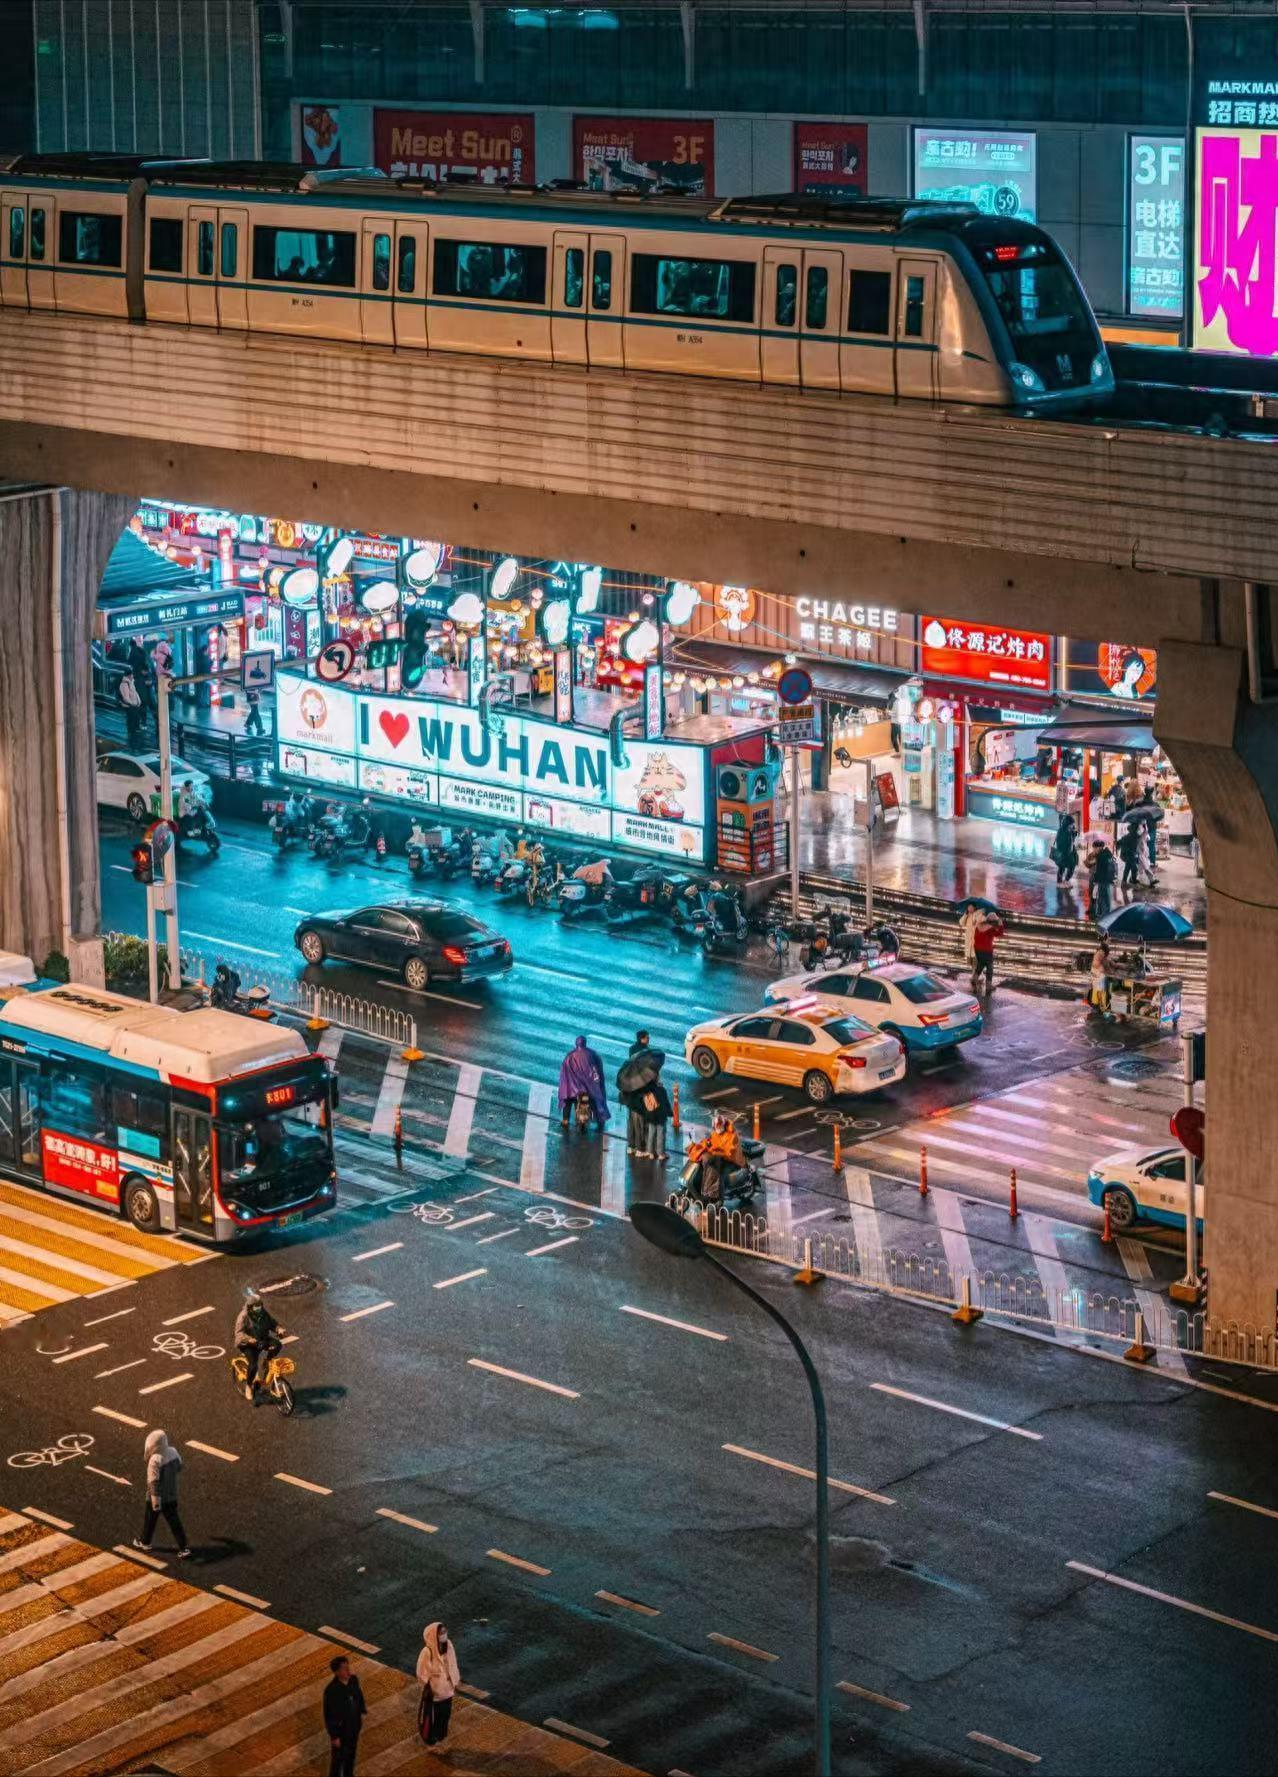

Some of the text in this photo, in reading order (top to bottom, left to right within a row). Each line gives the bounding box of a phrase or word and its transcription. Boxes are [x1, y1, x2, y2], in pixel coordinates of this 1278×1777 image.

[1208, 81, 1278, 94] MARKMA
[391, 127, 510, 161] Meet Sun
[673, 135, 705, 165] 3F
[1135, 144, 1182, 186] 3F
[1135, 199, 1181, 229] 电梯
[1134, 229, 1181, 259] 直达
[796, 597, 897, 631] CHAGEE
[360, 703, 607, 791] I WUHAN
[454, 785, 516, 804] MARK CAMPING
[258, 1181, 271, 1191] 801
